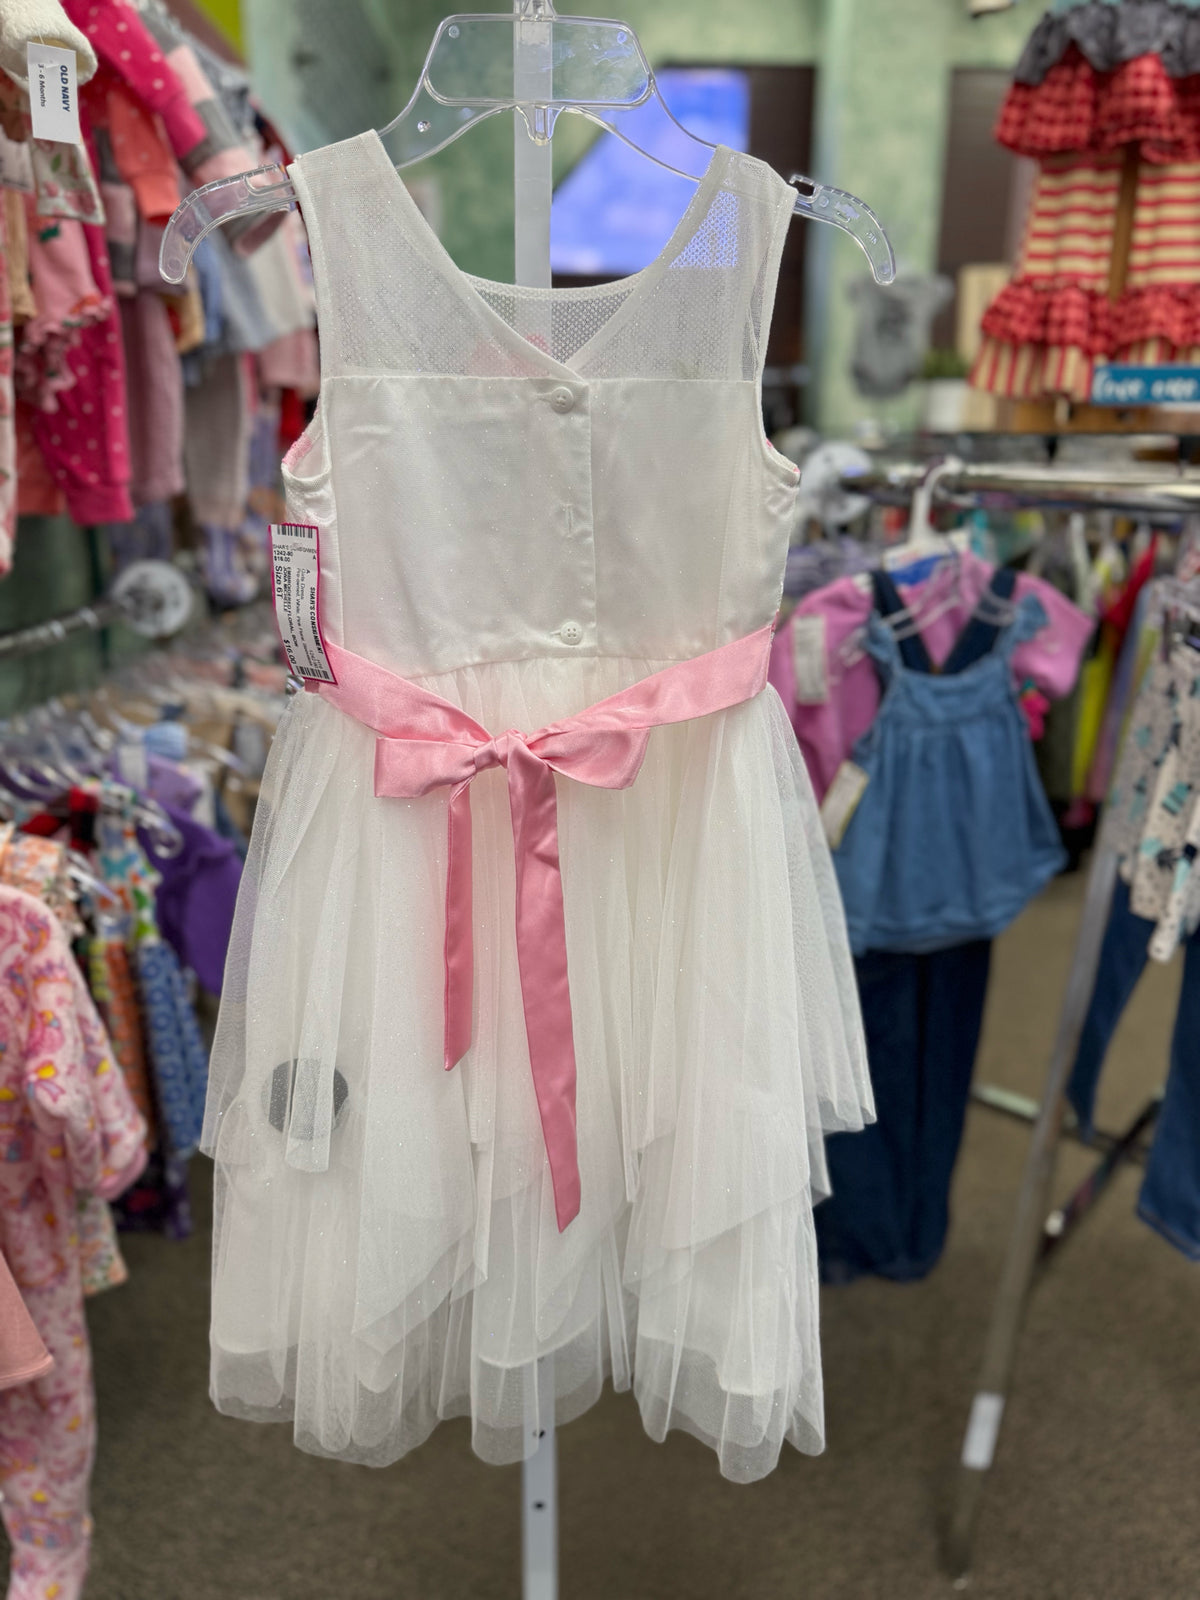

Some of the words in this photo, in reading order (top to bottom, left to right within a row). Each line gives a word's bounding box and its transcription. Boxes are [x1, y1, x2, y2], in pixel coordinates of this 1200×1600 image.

[60, 65, 69, 85] OLD
[39, 80, 47, 107] Months
[61, 86, 71, 112] NAVY
[275, 565, 283, 585] Size
[276, 587, 284, 600] 6T
[310, 611, 324, 655] CONSIGNMENT
[283, 639, 297, 665] $16.00
